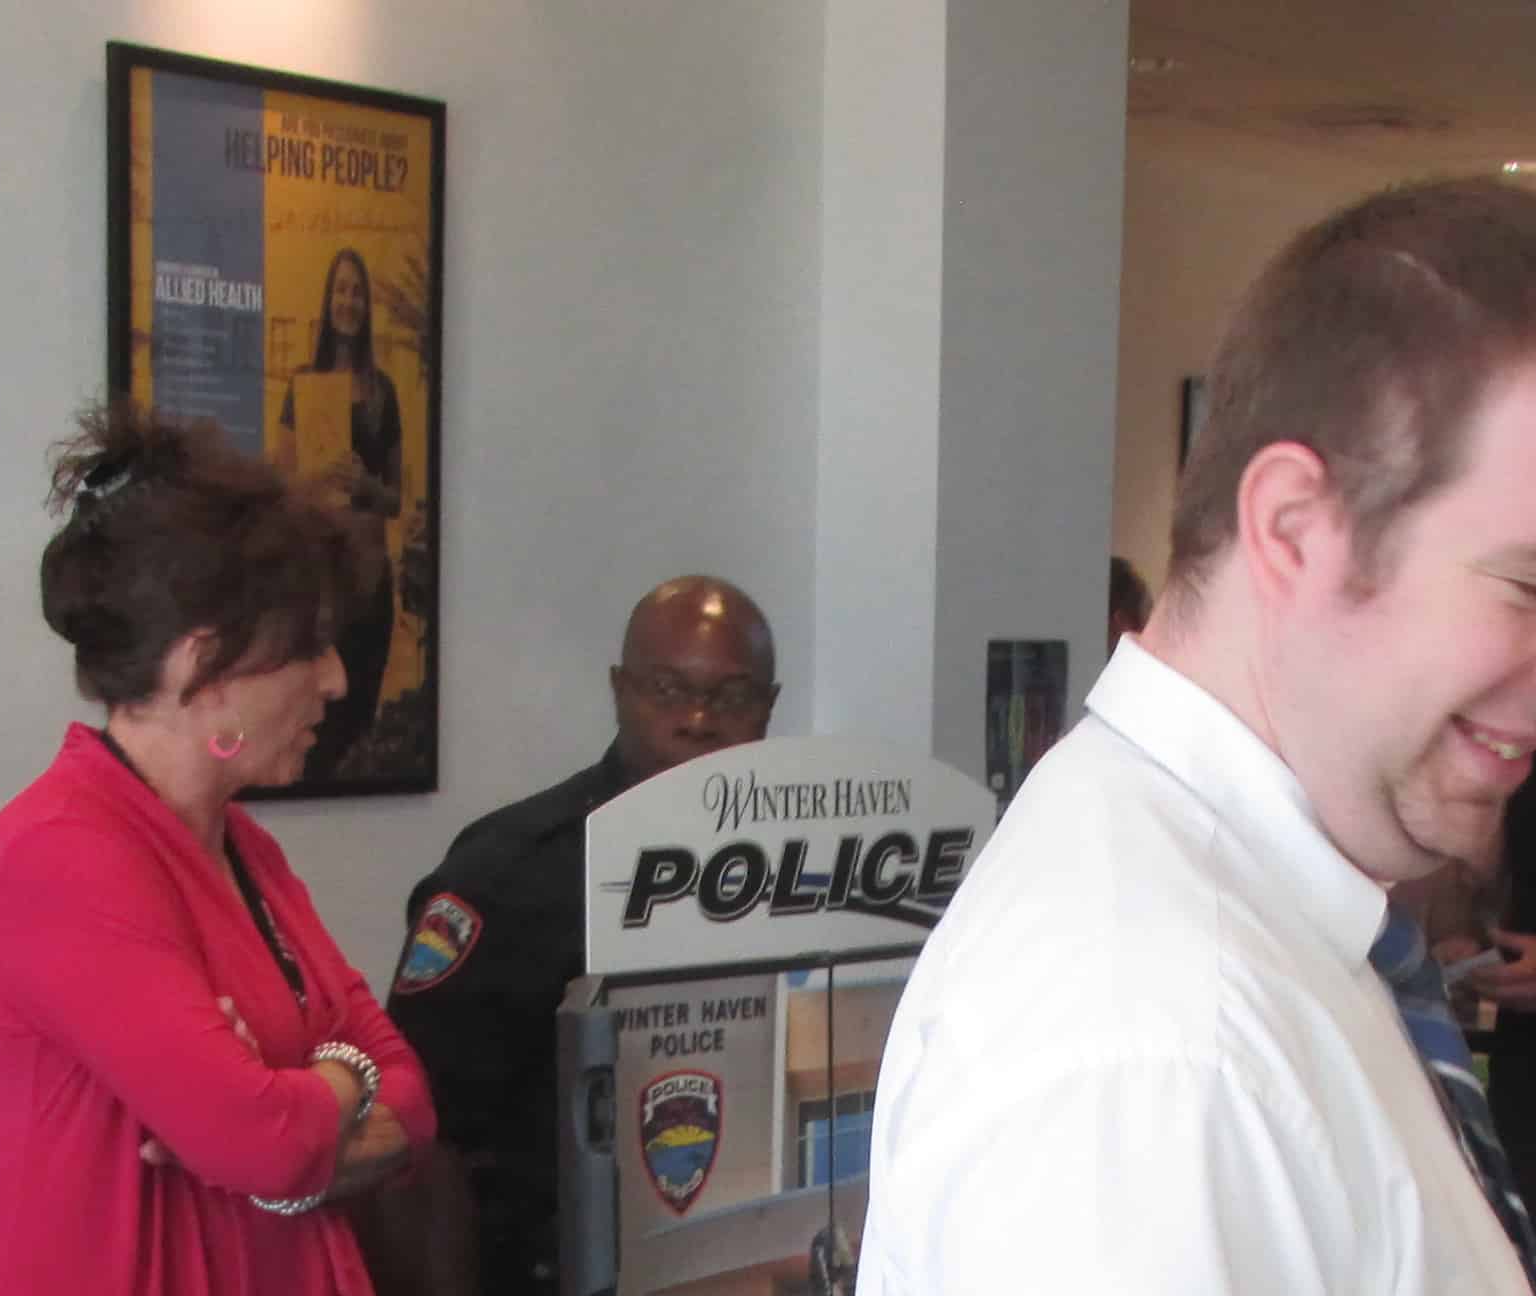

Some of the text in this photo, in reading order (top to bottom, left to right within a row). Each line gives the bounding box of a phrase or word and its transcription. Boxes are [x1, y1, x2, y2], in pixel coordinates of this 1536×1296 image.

[224, 127, 315, 181] HELPING
[321, 145, 409, 193] PEOPLE?
[208, 279, 263, 312] HEALTH
[703, 769, 913, 833] WINTER HAVEN
[621, 826, 976, 929] POLICE
[613, 996, 767, 1031] WINTER HAVEN
[650, 1028, 725, 1059] POLICE
